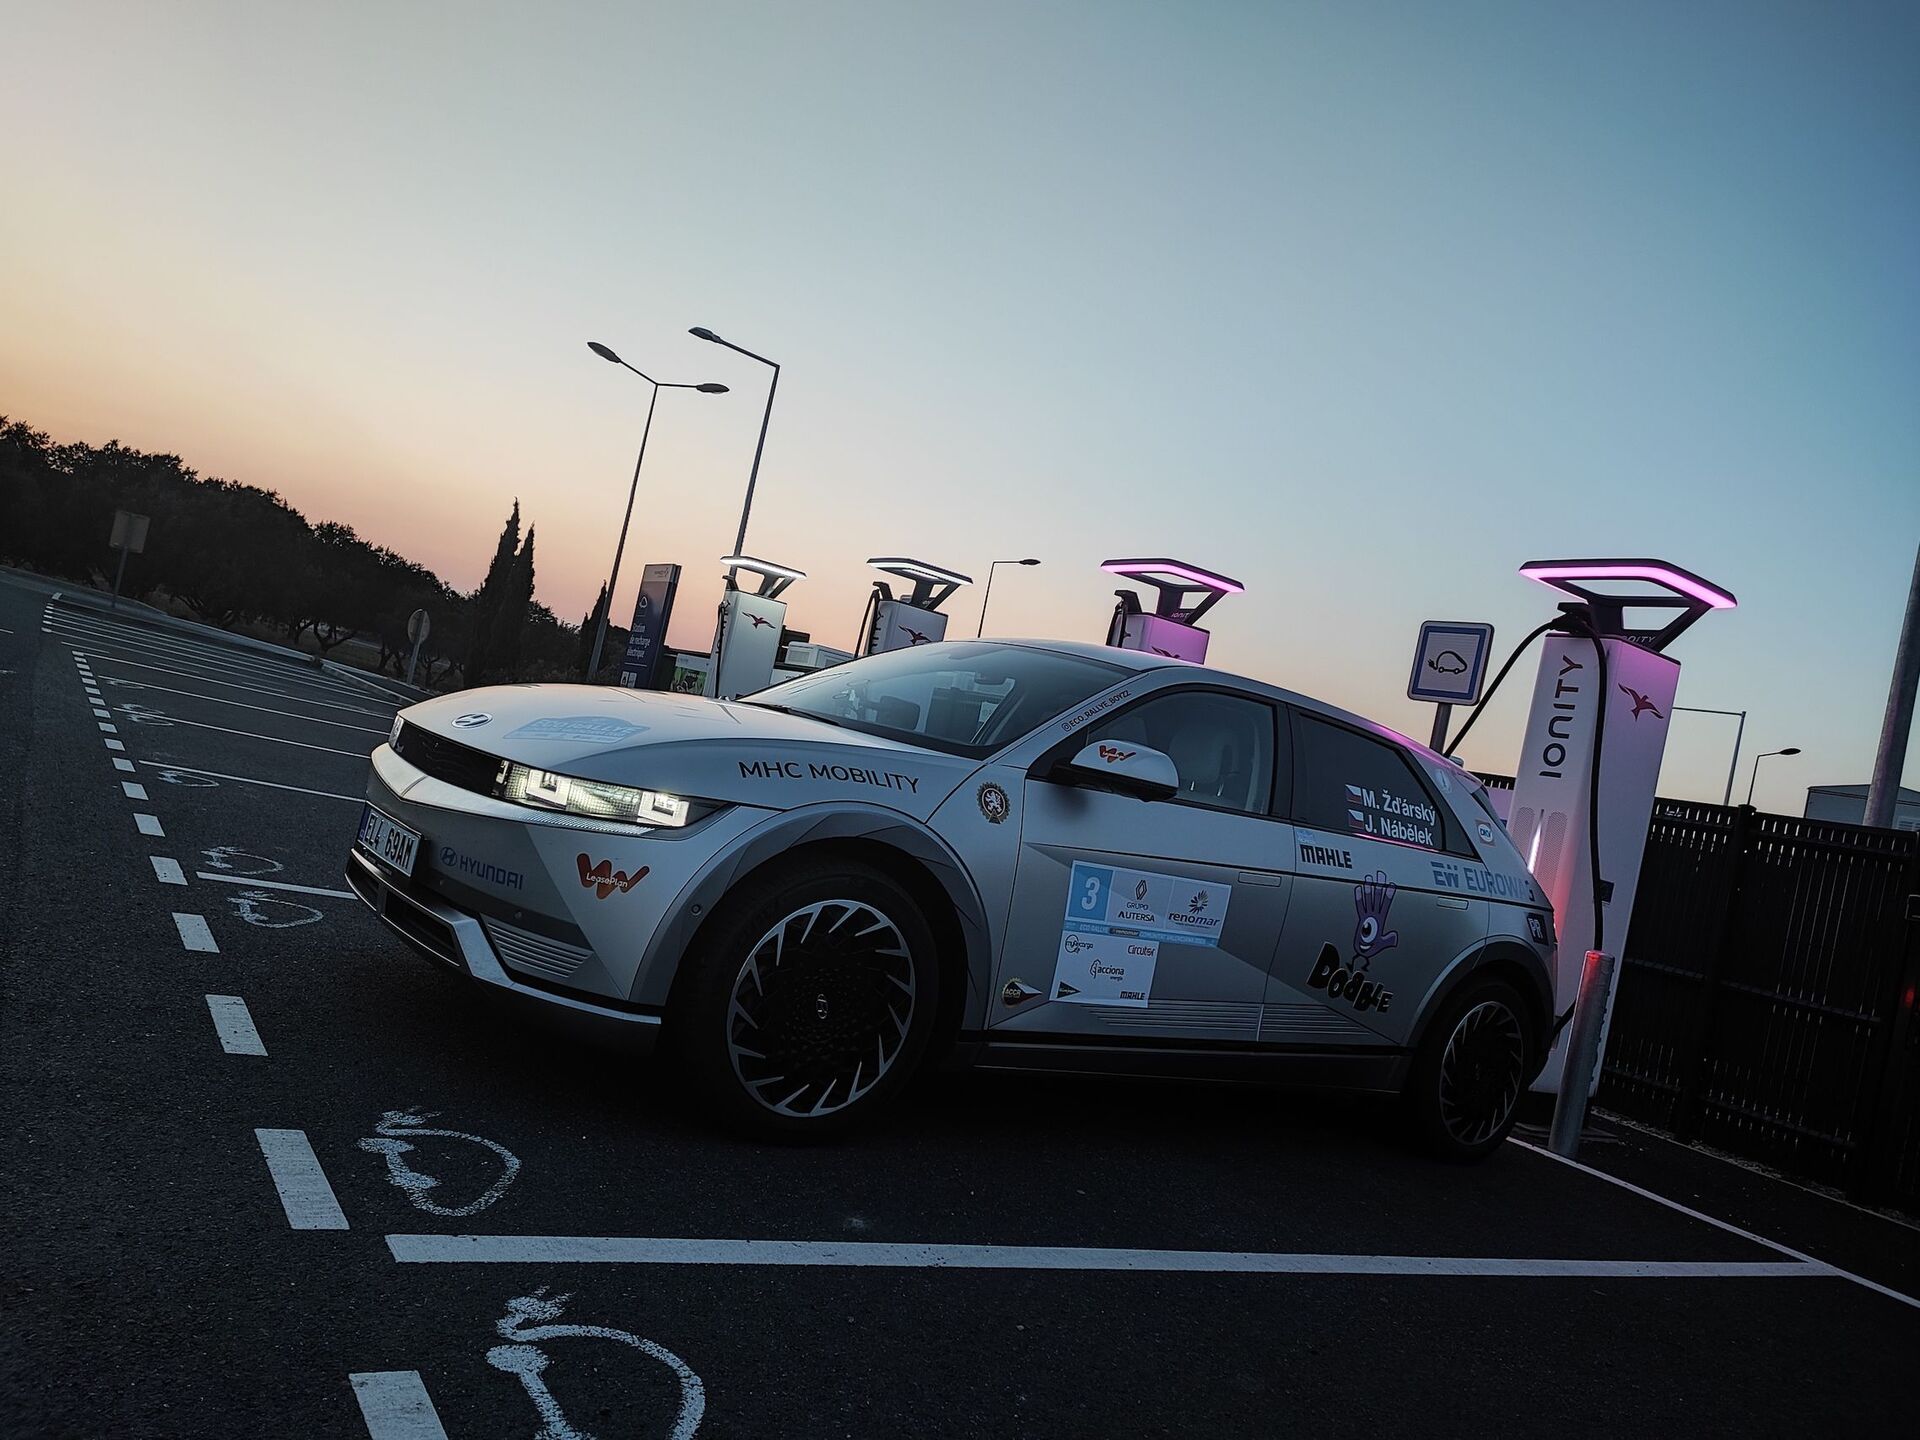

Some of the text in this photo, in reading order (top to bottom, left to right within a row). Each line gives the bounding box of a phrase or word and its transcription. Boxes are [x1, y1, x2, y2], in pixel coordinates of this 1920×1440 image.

[1539, 655, 1583, 779] IONITY
[738, 761, 919, 793] MHC MOBILITY
[1362, 788, 1436, 826] M. Žďárský
[1365, 814, 1434, 846] J. Nábělek
[1300, 844, 1352, 869] MAHLE
[459, 855, 524, 889] HYUNDAI
[585, 872, 628, 888] LeasePlan
[1081, 877, 1101, 911] 3
[1126, 902, 1149, 911] GRUPO
[1118, 911, 1155, 922] AUTERSA
[1168, 912, 1220, 926] renomar
[1097, 965, 1125, 976] acciona
[1120, 991, 1146, 1000] MAHLE
